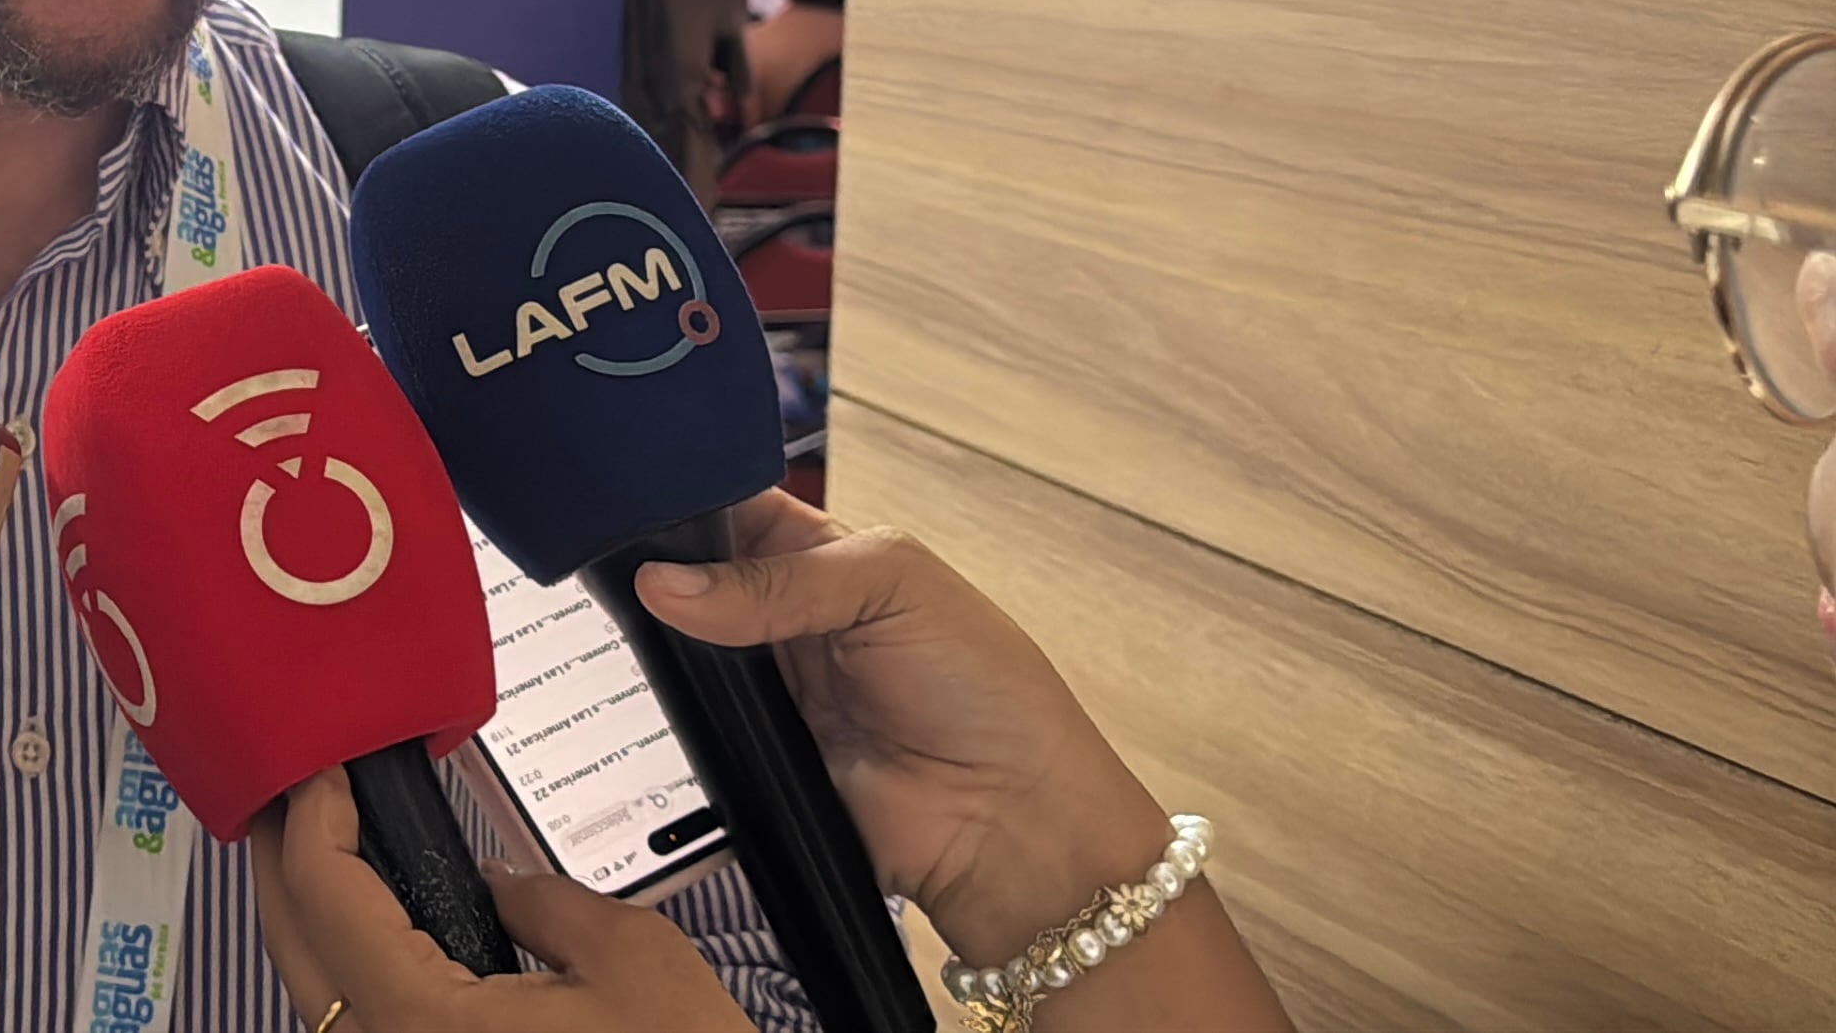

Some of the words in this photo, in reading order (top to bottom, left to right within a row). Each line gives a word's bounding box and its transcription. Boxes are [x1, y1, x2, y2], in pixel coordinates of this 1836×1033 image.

[543, 665, 565, 680] Las
[571, 708, 593, 723] Las
[520, 718, 572, 748] Americas
[505, 743, 521, 756] 21
[600, 751, 622, 766] Las
[548, 762, 600, 792] Americas
[532, 787, 550, 802] 22
